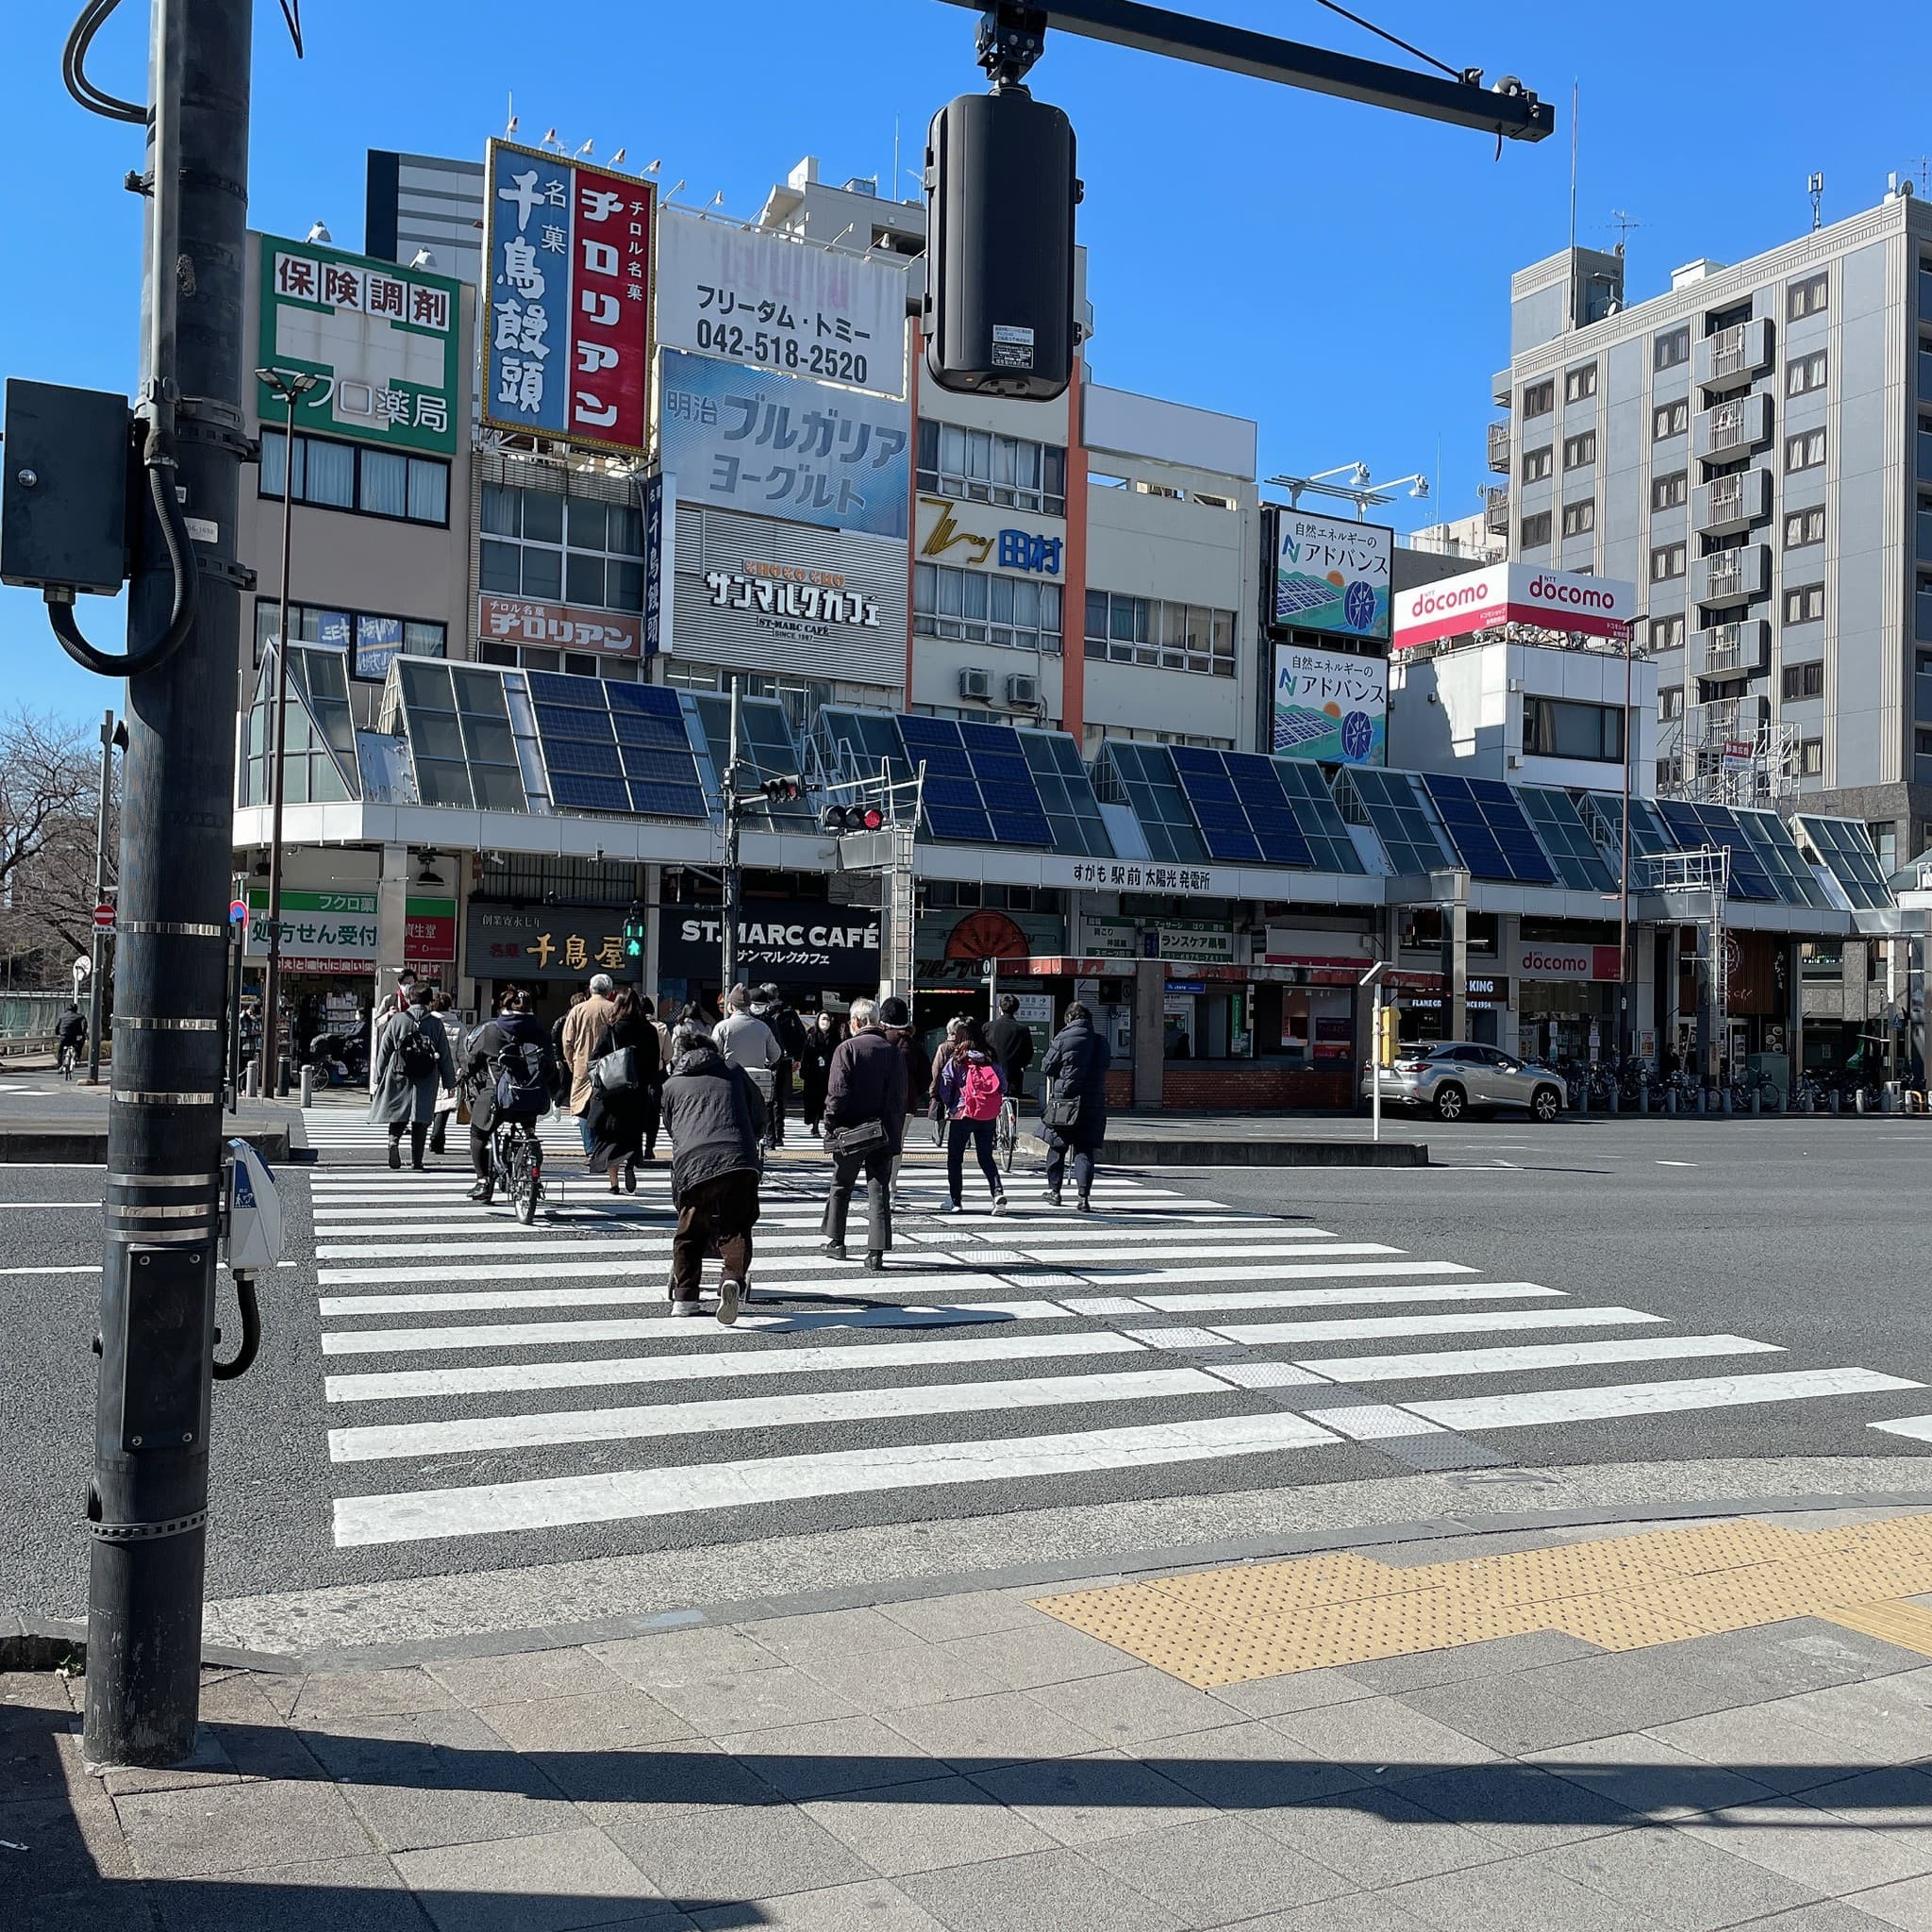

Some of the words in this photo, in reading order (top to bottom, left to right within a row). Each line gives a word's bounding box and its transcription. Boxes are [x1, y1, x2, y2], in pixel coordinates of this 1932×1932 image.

[541, 179, 567, 256] 名菓
[627, 201, 645, 301] チロル名菓
[279, 257, 448, 326] 保険調剤
[493, 170, 550, 413] 千鳥饅頭
[575, 189, 624, 427] チロリアン
[697, 319, 867, 383] 042-518-2520
[666, 390, 718, 425] 明治
[724, 393, 907, 469] ブルガリア
[709, 454, 865, 513] ヨーグルト
[999, 529, 1063, 575] 田村
[1295, 522, 1377, 549] 自然エネルギーの
[1305, 542, 1388, 575] アドバンス
[491, 600, 545, 617] チロル名菓
[707, 572, 880, 626] サンマルクカフェ
[1412, 583, 1488, 618] docomo
[1529, 575, 1614, 608] docomo
[491, 613, 632, 650] チロリアン
[1292, 655, 1374, 677] 自然エネルギーの
[1302, 675, 1385, 704] アドバンス
[319, 896, 378, 912] フクロ薬
[526, 932, 625, 971] 千鳥屋
[808, 923, 879, 949] CAFÉ
[1523, 951, 1587, 971] docomo
[1469, 980, 1493, 992] KING
